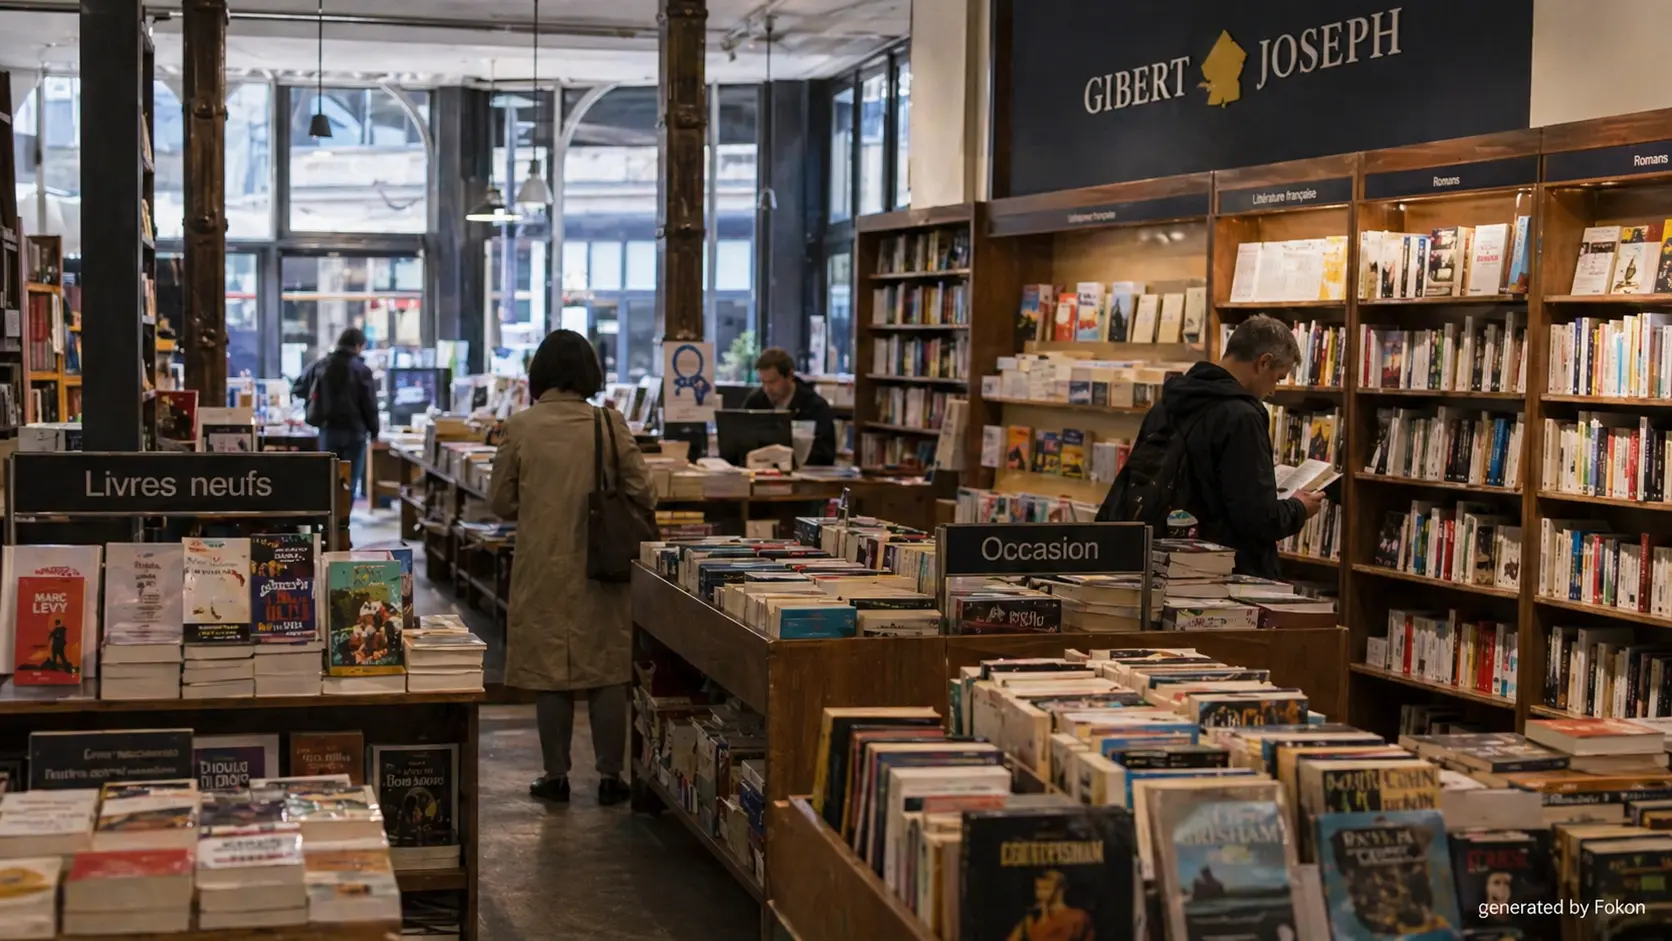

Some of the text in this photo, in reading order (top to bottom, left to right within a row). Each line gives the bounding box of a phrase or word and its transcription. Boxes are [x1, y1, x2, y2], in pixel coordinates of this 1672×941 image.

[1083, 7, 1403, 114] GIBERT JOSEPH
[1634, 154, 1669, 166] Romans
[1433, 176, 1460, 187] Romans
[85, 470, 273, 497] Livres neufs
[981, 536, 1098, 561] Occasion
[35, 592, 68, 602] MARC
[32, 602, 68, 614] LEVY
